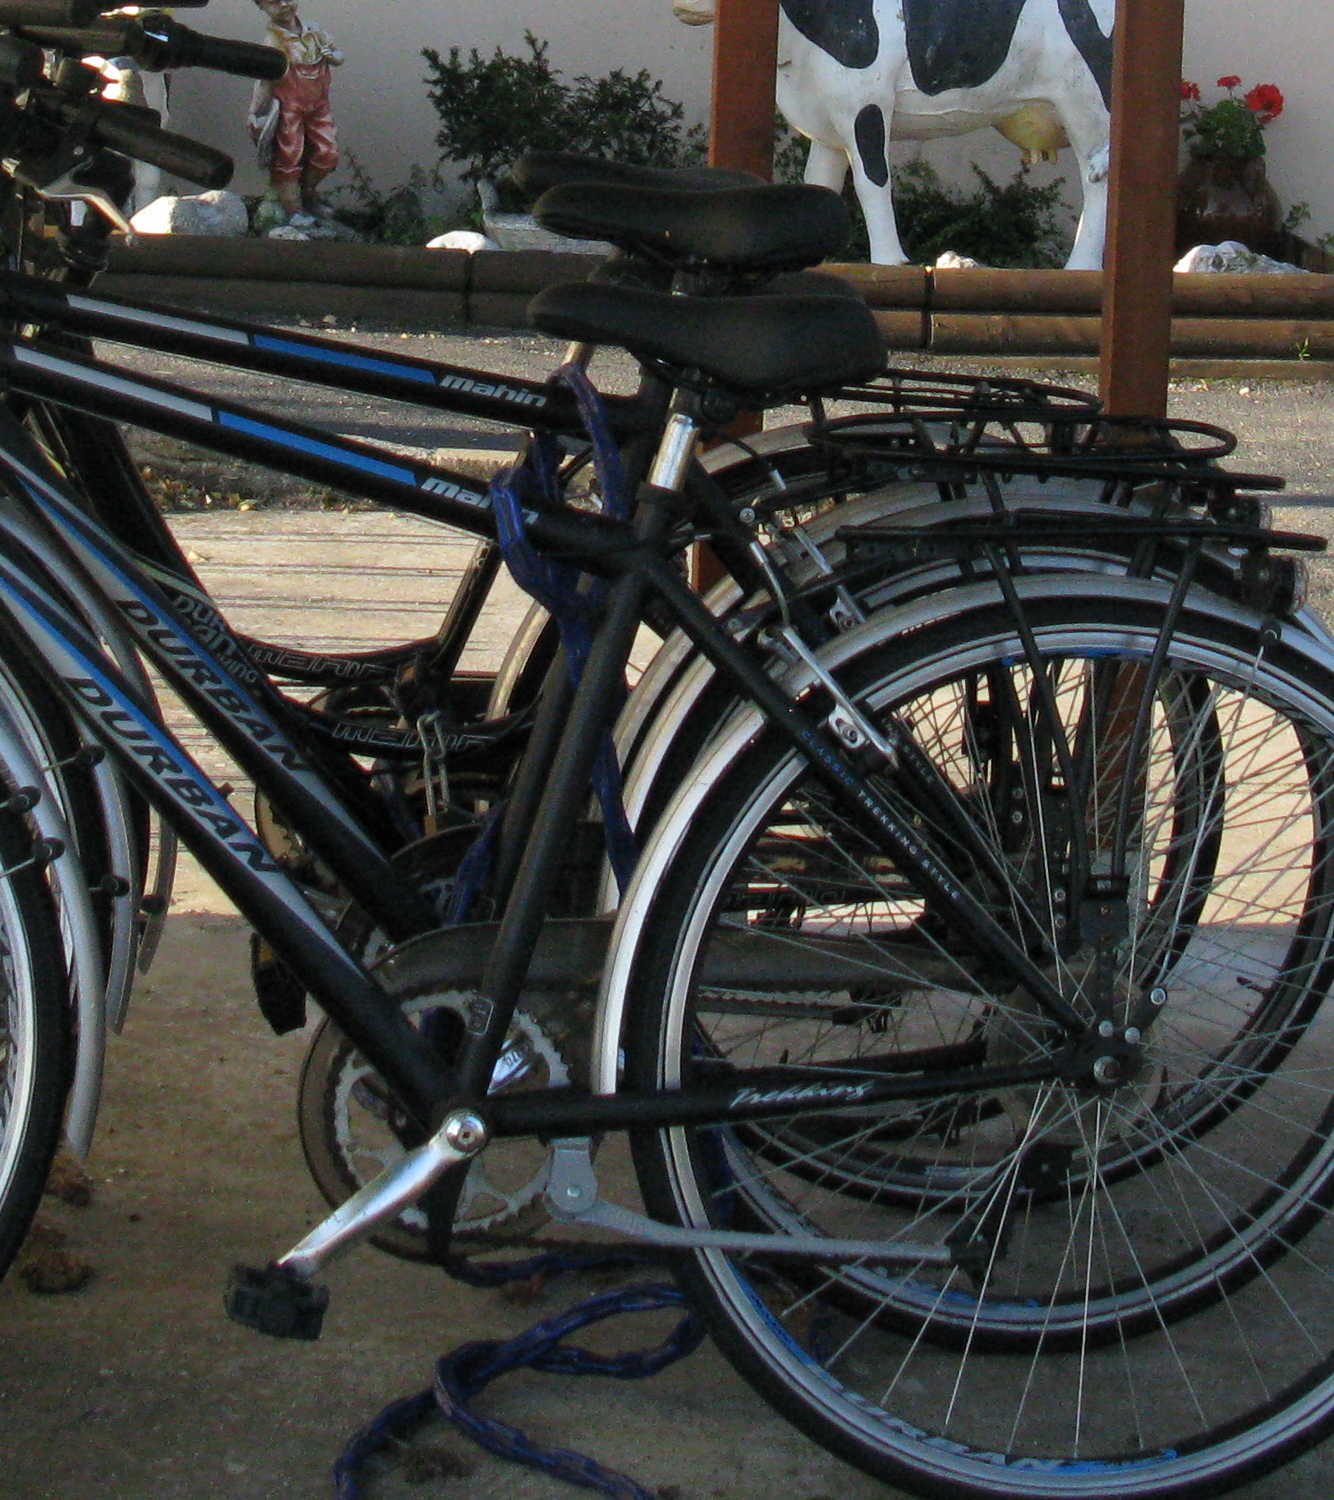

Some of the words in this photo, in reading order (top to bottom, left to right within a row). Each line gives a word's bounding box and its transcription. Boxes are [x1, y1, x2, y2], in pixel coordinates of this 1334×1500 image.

[118, 600, 313, 771] DURBAN
[66, 677, 280, 872] DURBAN
[856, 789, 919, 855] TREKKING
[921, 858, 961, 900] STYLE
